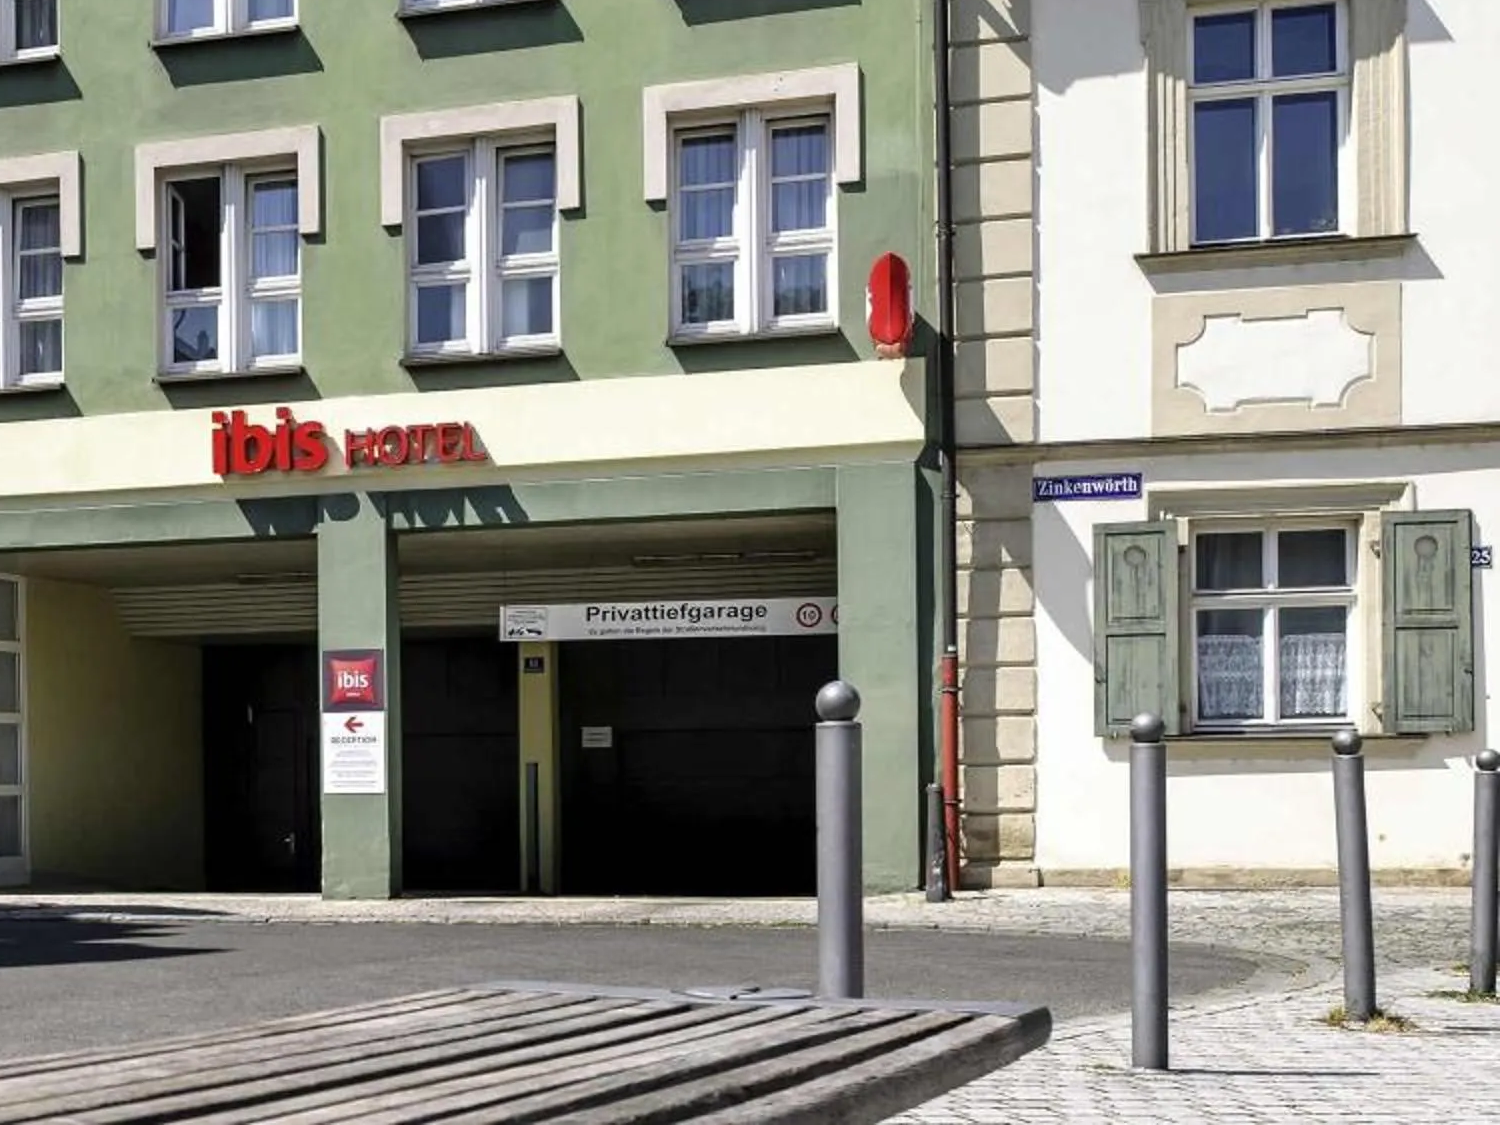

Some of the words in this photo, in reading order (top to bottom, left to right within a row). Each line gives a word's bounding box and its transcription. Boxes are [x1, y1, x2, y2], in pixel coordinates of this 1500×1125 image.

[211, 406, 329, 475] ibis
[345, 422, 487, 468] HOTEL
[1037, 477, 1137, 496] Zinkenwörth
[1471, 550, 1490, 564] 25
[585, 602, 768, 624] Privattiefgarage
[338, 671, 369, 689] ibis
